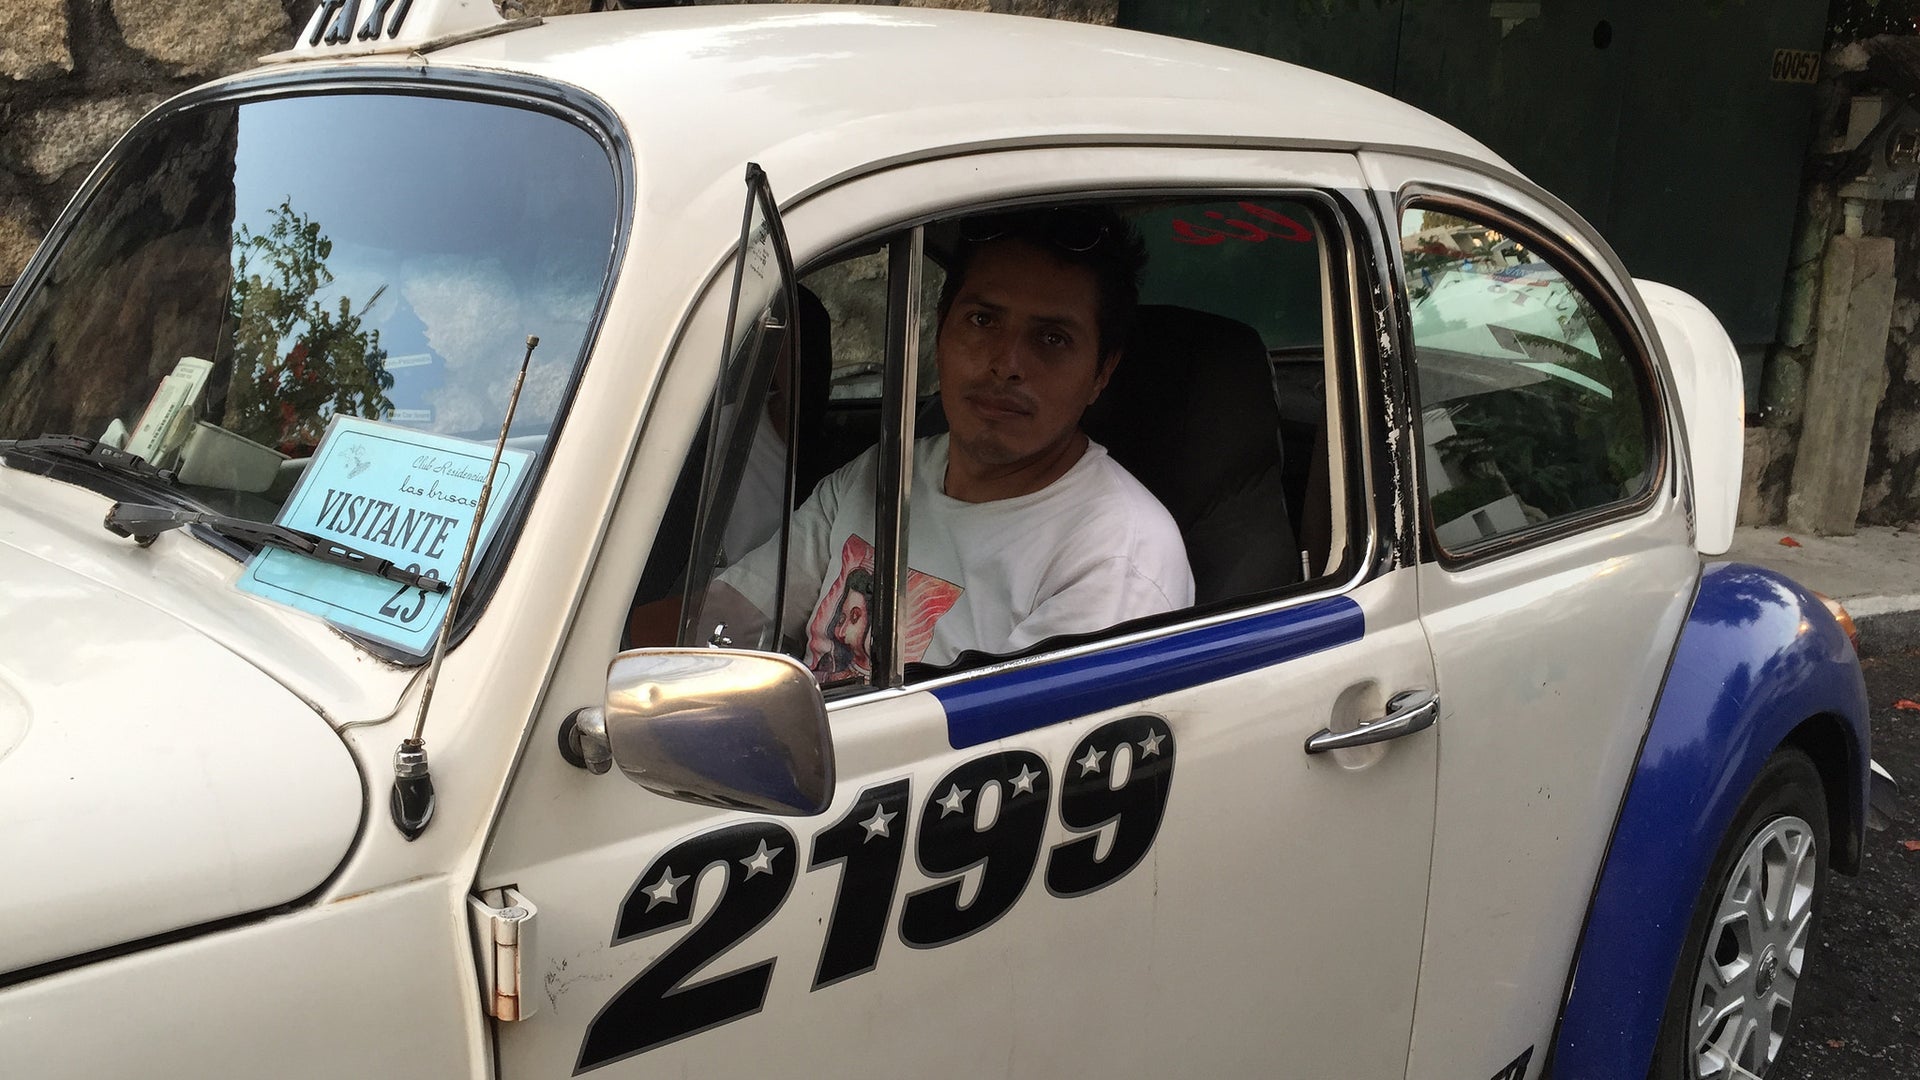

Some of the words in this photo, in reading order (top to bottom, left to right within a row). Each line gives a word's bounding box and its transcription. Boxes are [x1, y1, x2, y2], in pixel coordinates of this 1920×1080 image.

[309, 0, 413, 46] TAXI
[1772, 51, 1820, 80] 60057
[412, 455, 436, 471] Club
[399, 475, 424, 496] las
[428, 480, 478, 508] brisas
[315, 488, 459, 560] VISITANTE
[379, 563, 439, 623] 23
[572, 712, 1176, 1076] 2199
